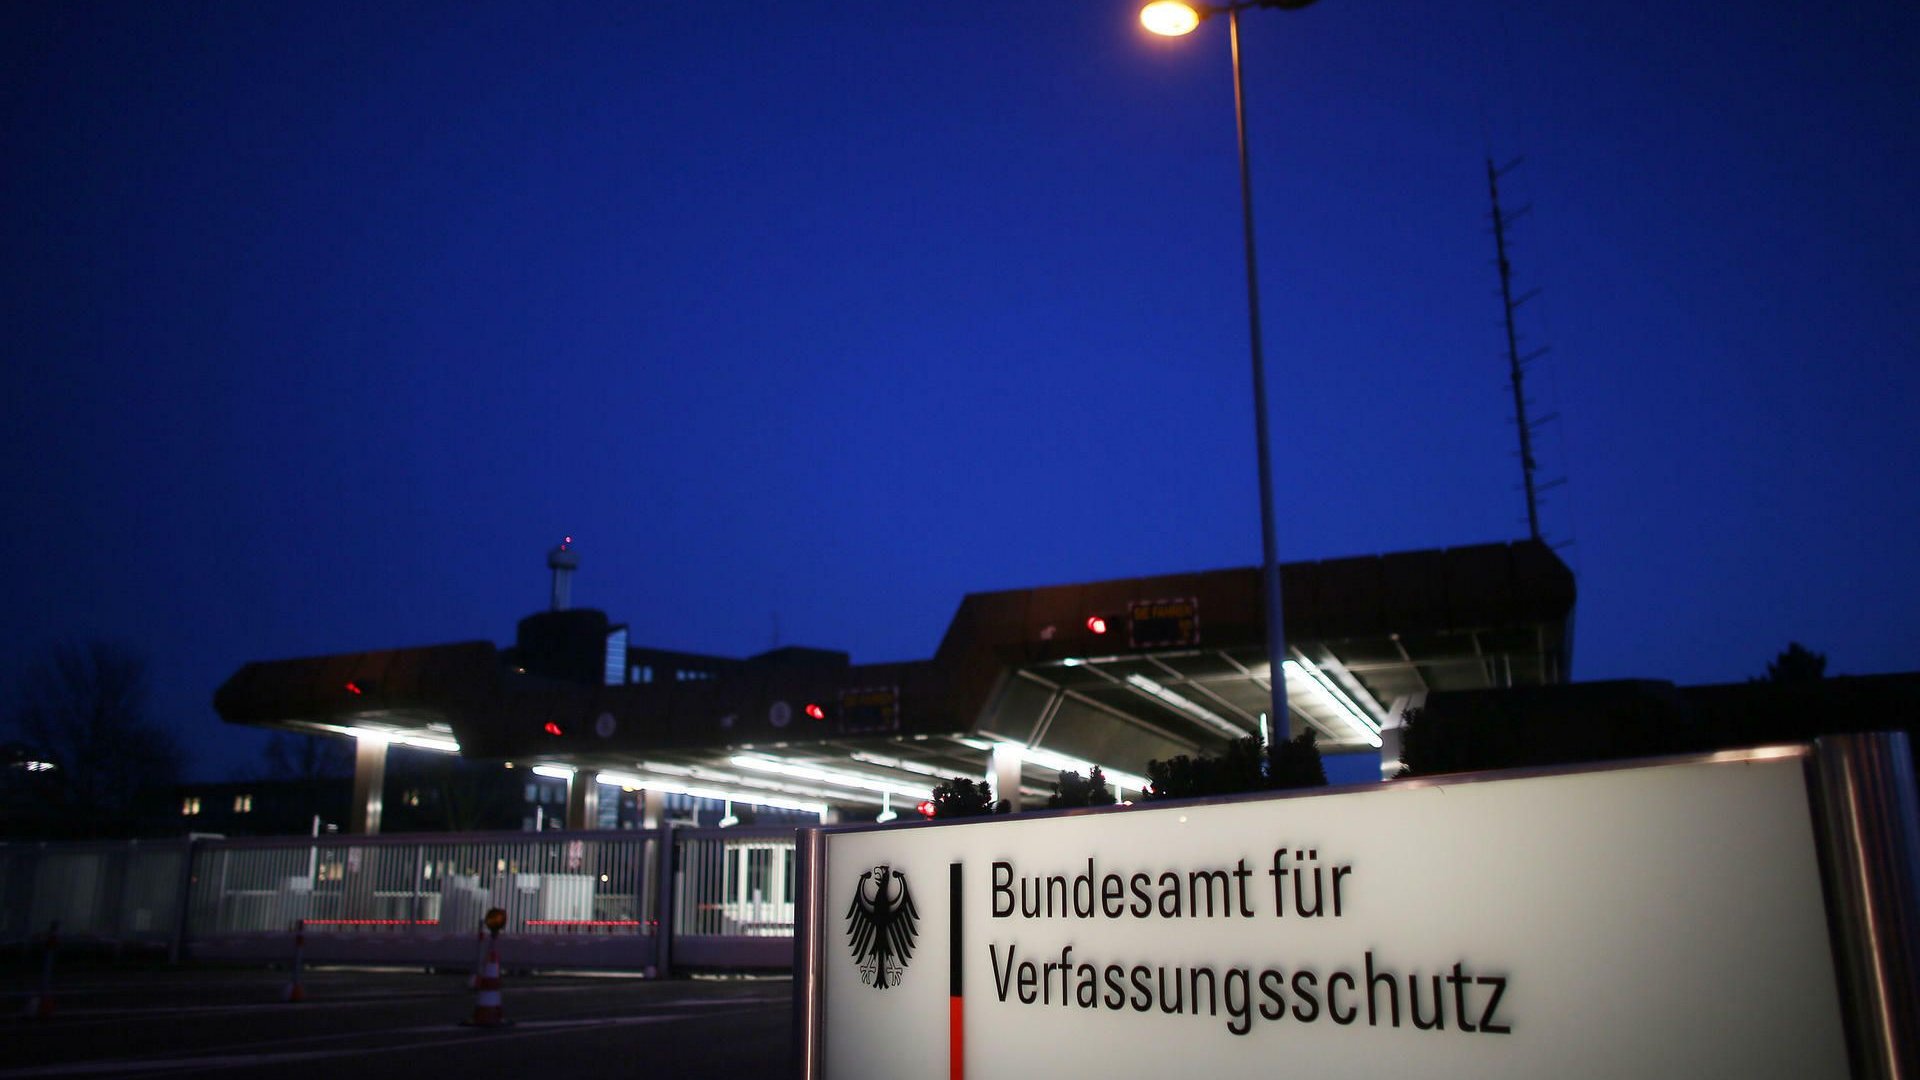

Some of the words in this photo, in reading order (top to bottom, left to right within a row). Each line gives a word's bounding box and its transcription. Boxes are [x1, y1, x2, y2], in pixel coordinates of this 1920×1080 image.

[992, 858, 1254, 918] Bundesamt
[1269, 849, 1351, 917] für
[989, 945, 1512, 1036] Verfassungsschutz
